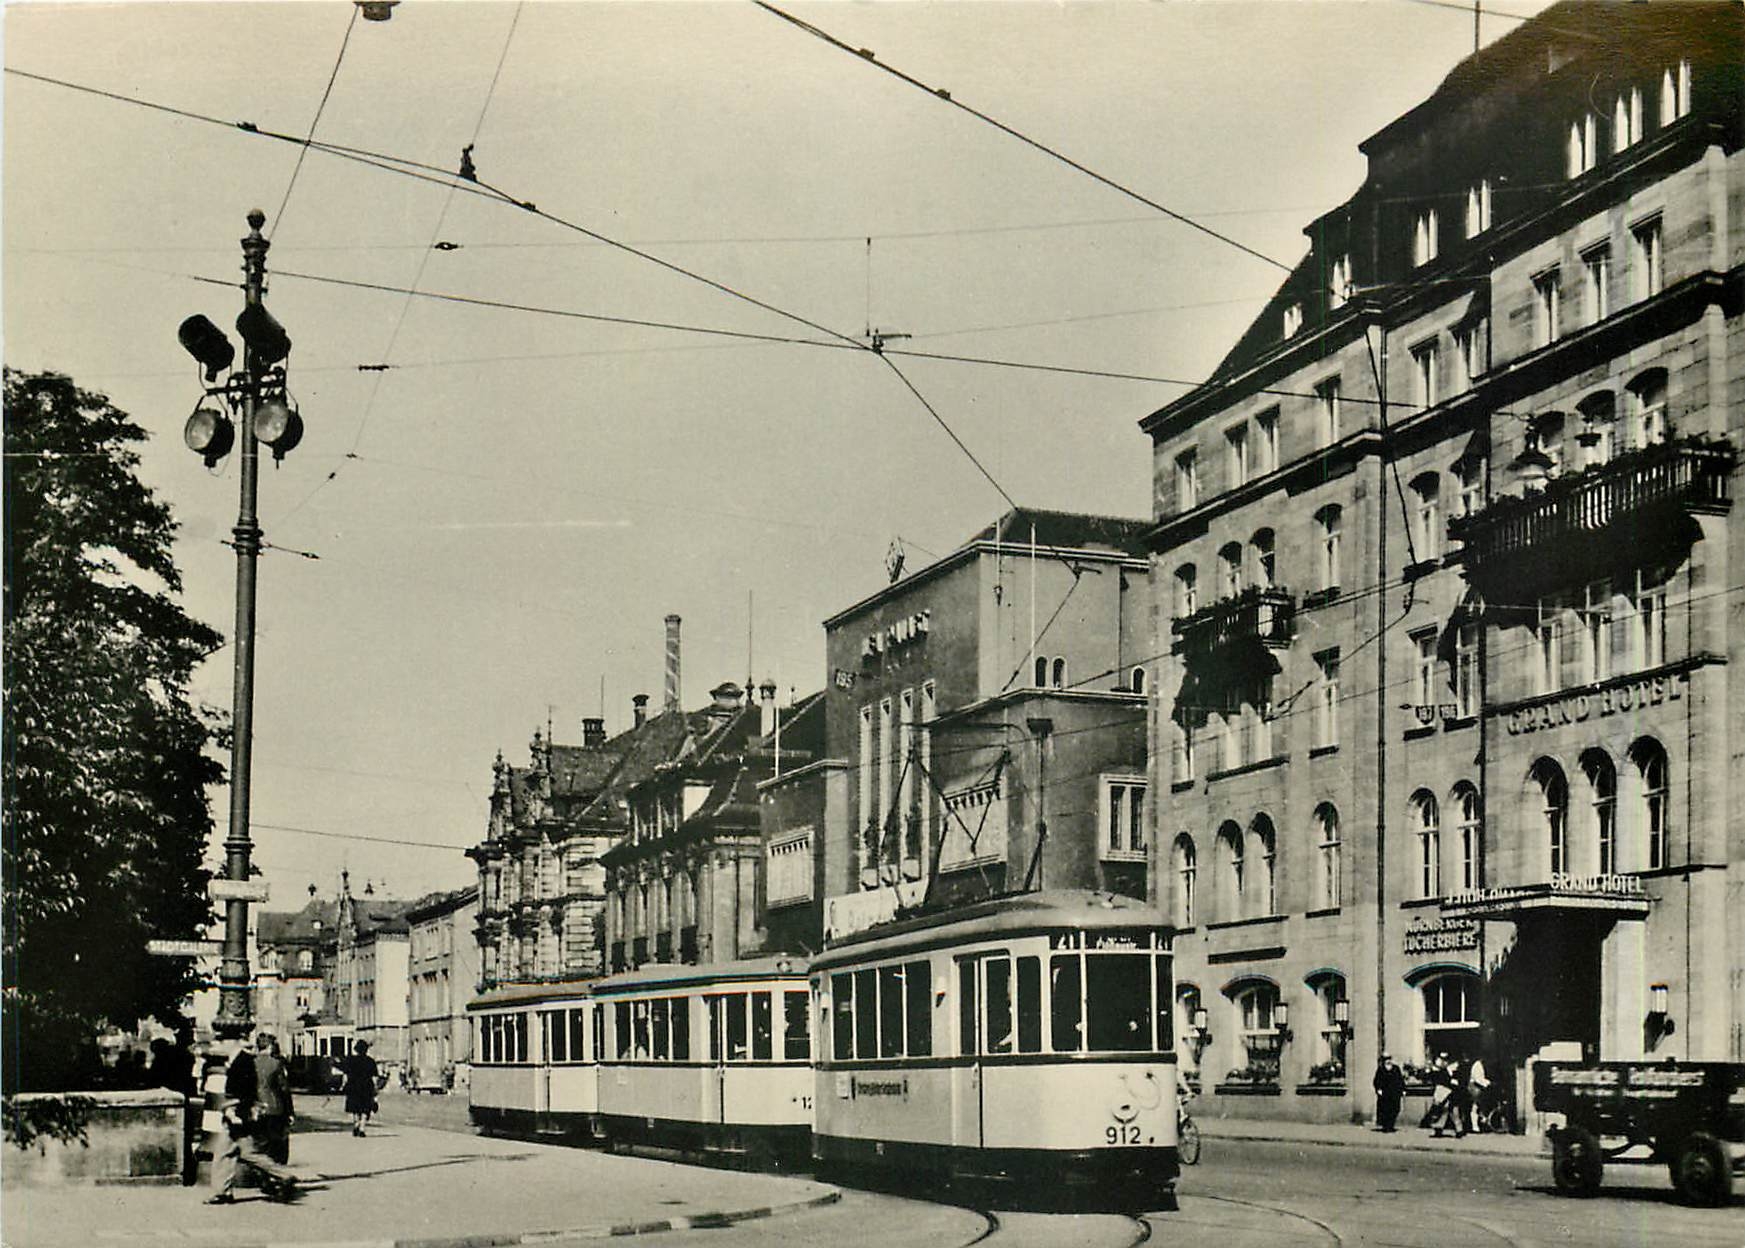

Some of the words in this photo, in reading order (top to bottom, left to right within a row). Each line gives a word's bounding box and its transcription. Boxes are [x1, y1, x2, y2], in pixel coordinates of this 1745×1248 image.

[1507, 695, 1590, 736] GRAND
[1600, 673, 1682, 717] HOTEL
[1550, 871, 1599, 892] GRAND
[1601, 873, 1645, 894] HOTEL
[1106, 1126, 1141, 1144] 912
